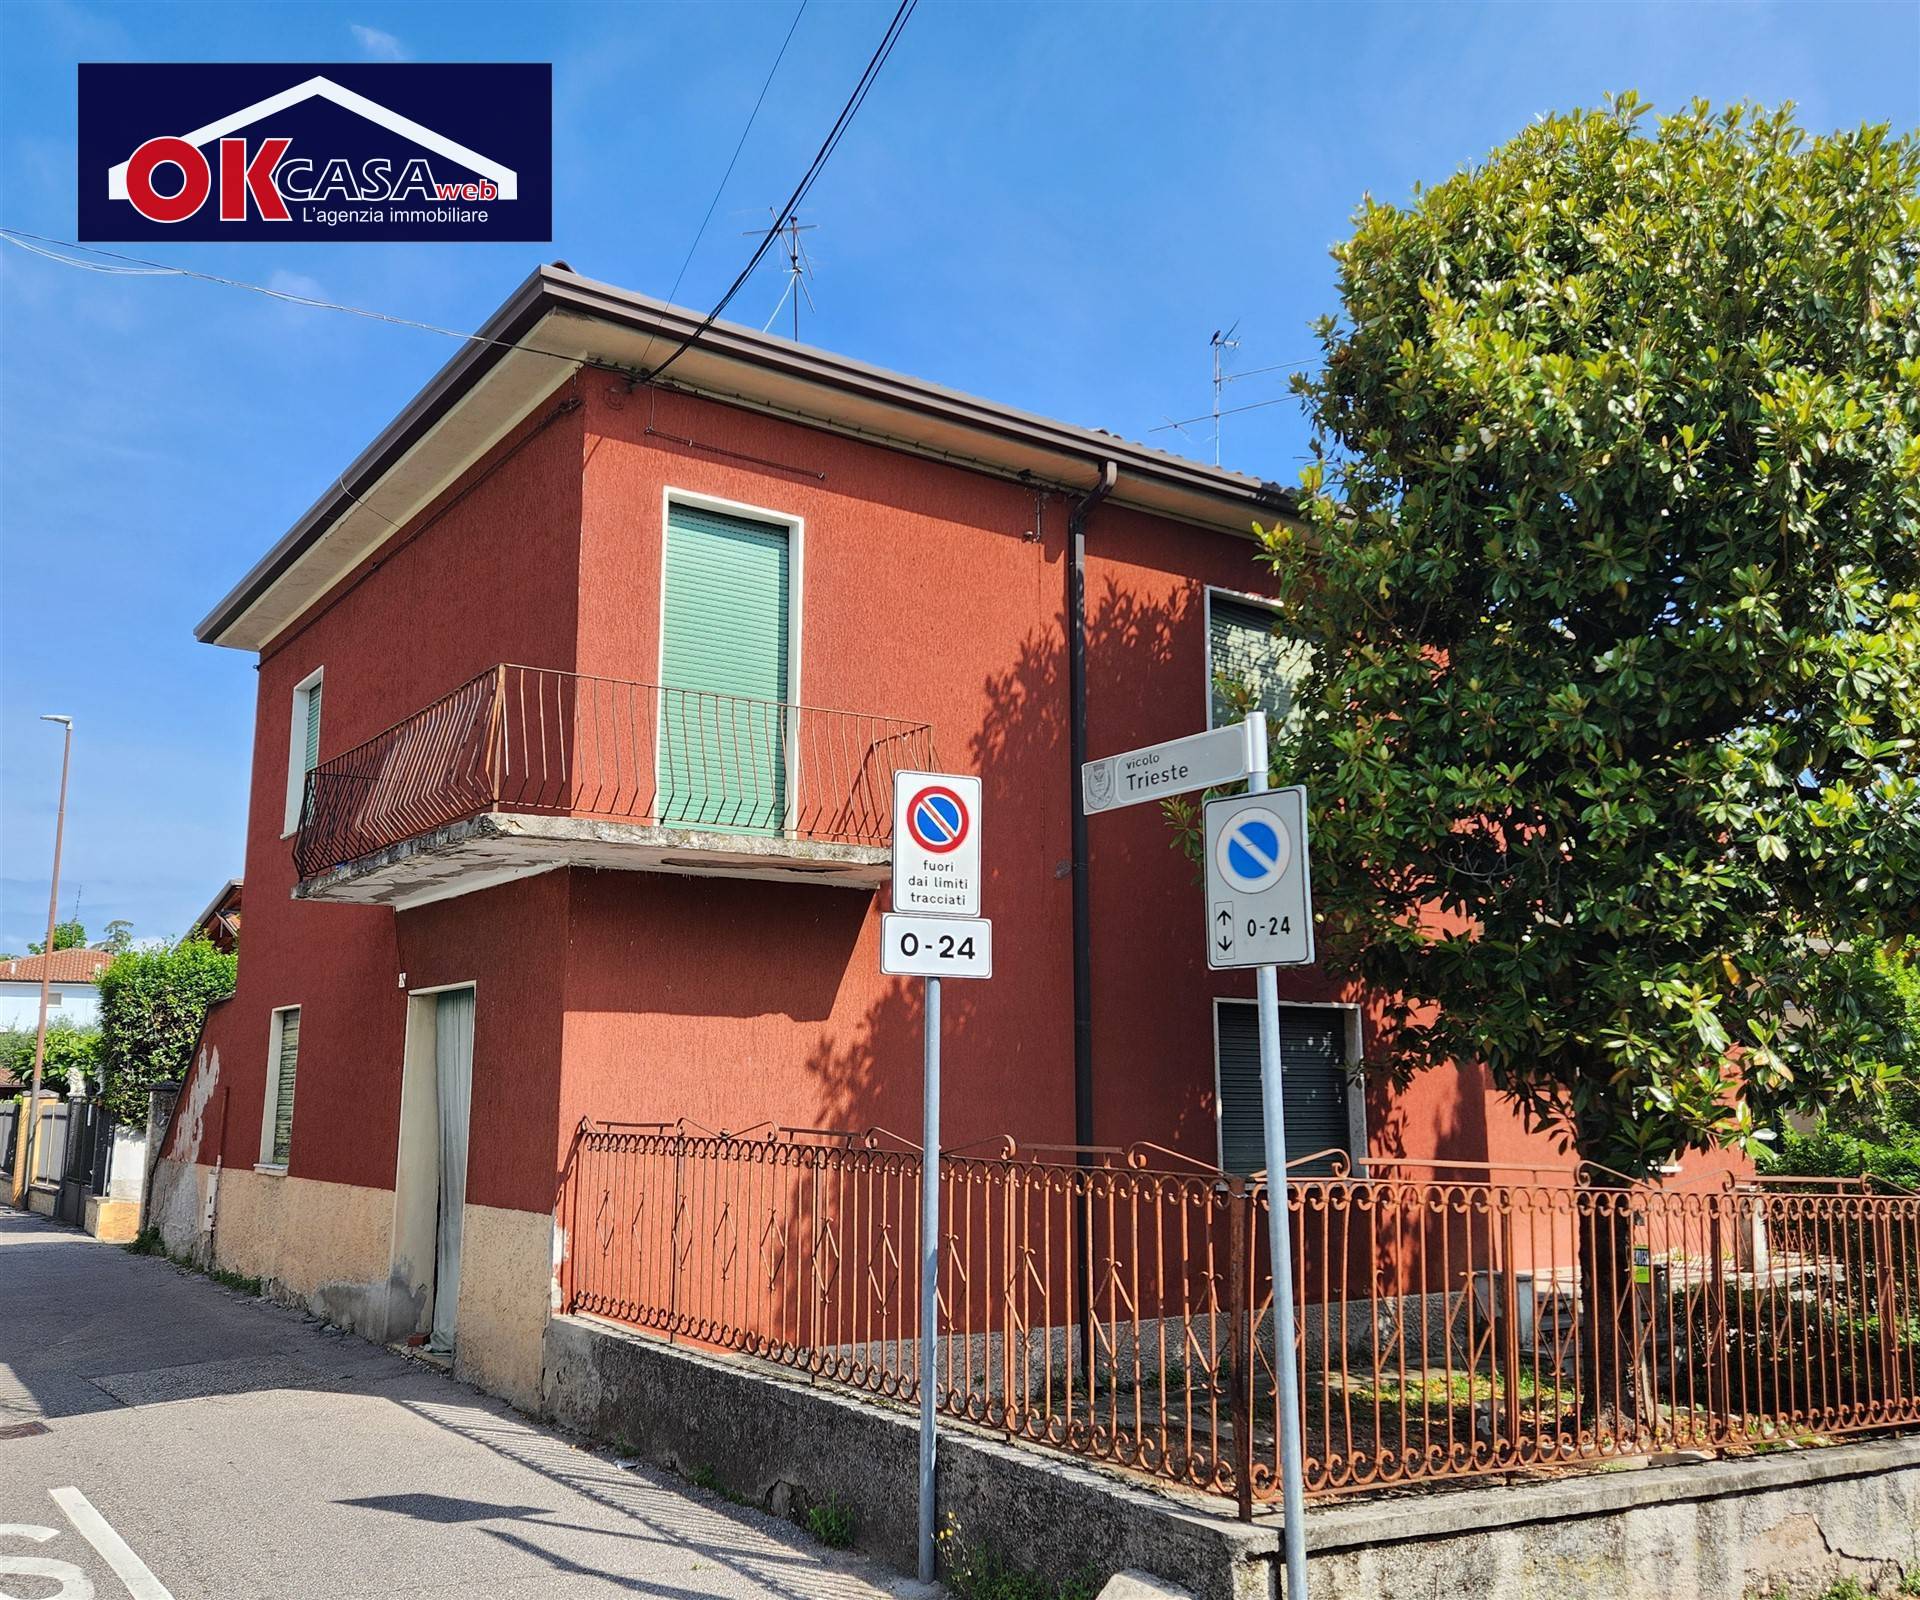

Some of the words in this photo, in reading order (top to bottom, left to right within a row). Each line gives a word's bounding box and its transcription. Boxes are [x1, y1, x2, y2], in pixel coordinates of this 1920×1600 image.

[1126, 754, 1160, 770] vicolo
[1126, 764, 1189, 791] Trieste
[923, 860, 954, 872] fuori
[908, 876, 928, 887] dai
[934, 877, 968, 889] limiti
[911, 892, 966, 905] tracciati
